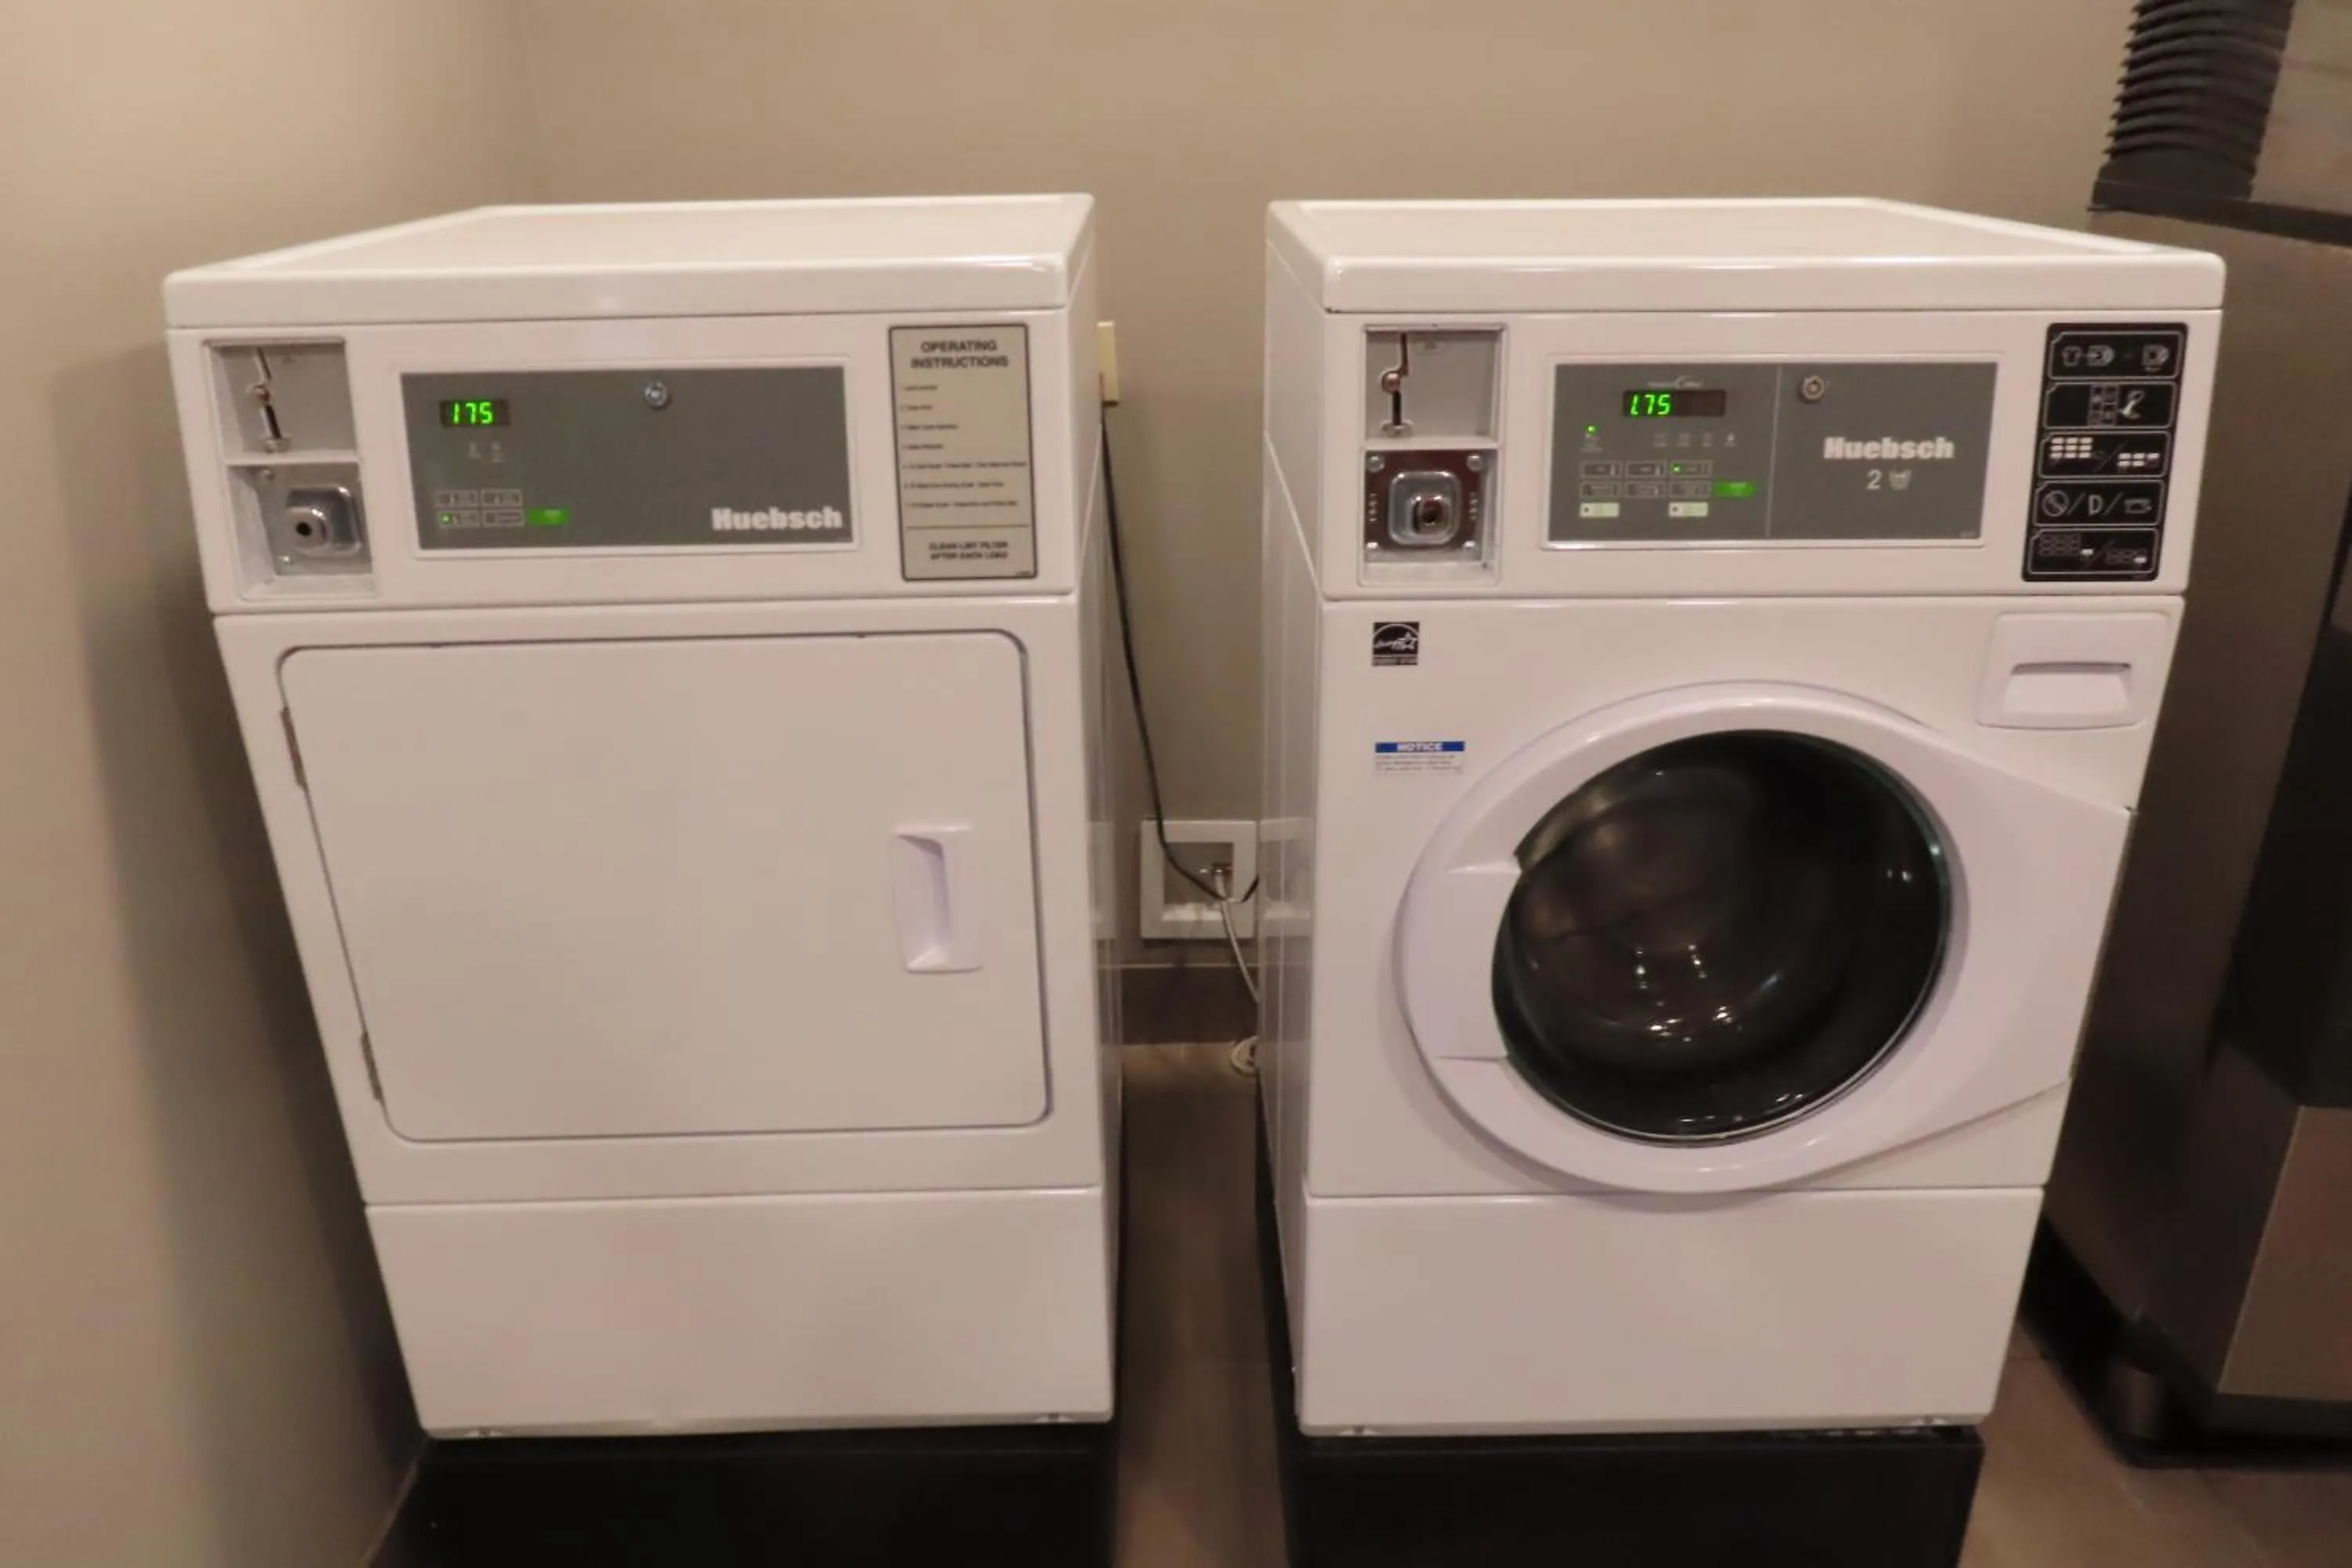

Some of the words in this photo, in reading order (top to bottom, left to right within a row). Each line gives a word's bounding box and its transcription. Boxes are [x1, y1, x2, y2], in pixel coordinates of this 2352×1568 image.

[920, 339, 998, 353] OPERATING
[909, 355, 1009, 369] INSTRUCTIONS
[1824, 436, 1955, 459] Huebsch
[1866, 469, 1882, 490] 2
[711, 505, 843, 531] Huebsch
